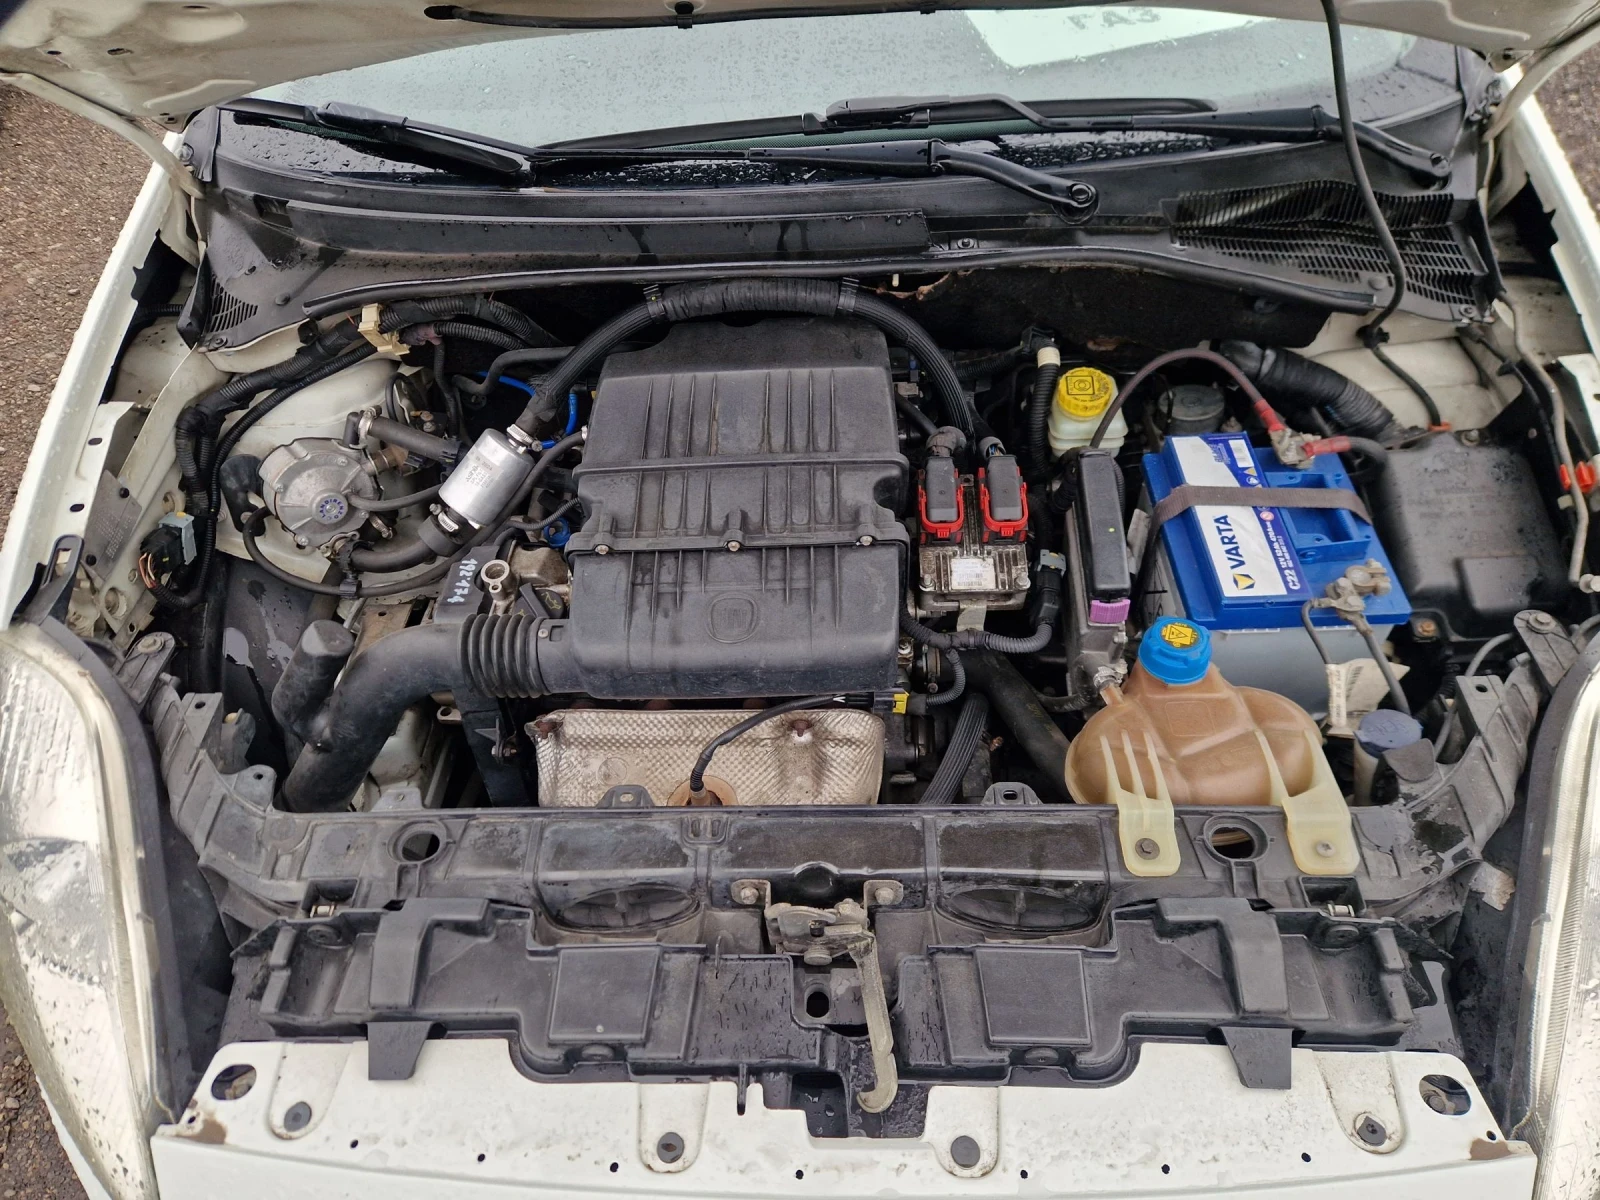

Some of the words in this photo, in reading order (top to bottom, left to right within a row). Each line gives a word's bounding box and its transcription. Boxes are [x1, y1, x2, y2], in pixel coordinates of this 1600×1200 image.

[1213, 514, 1246, 570] VARTA
[1278, 557, 1287, 569] 12V
[1284, 569, 1301, 590] C22
